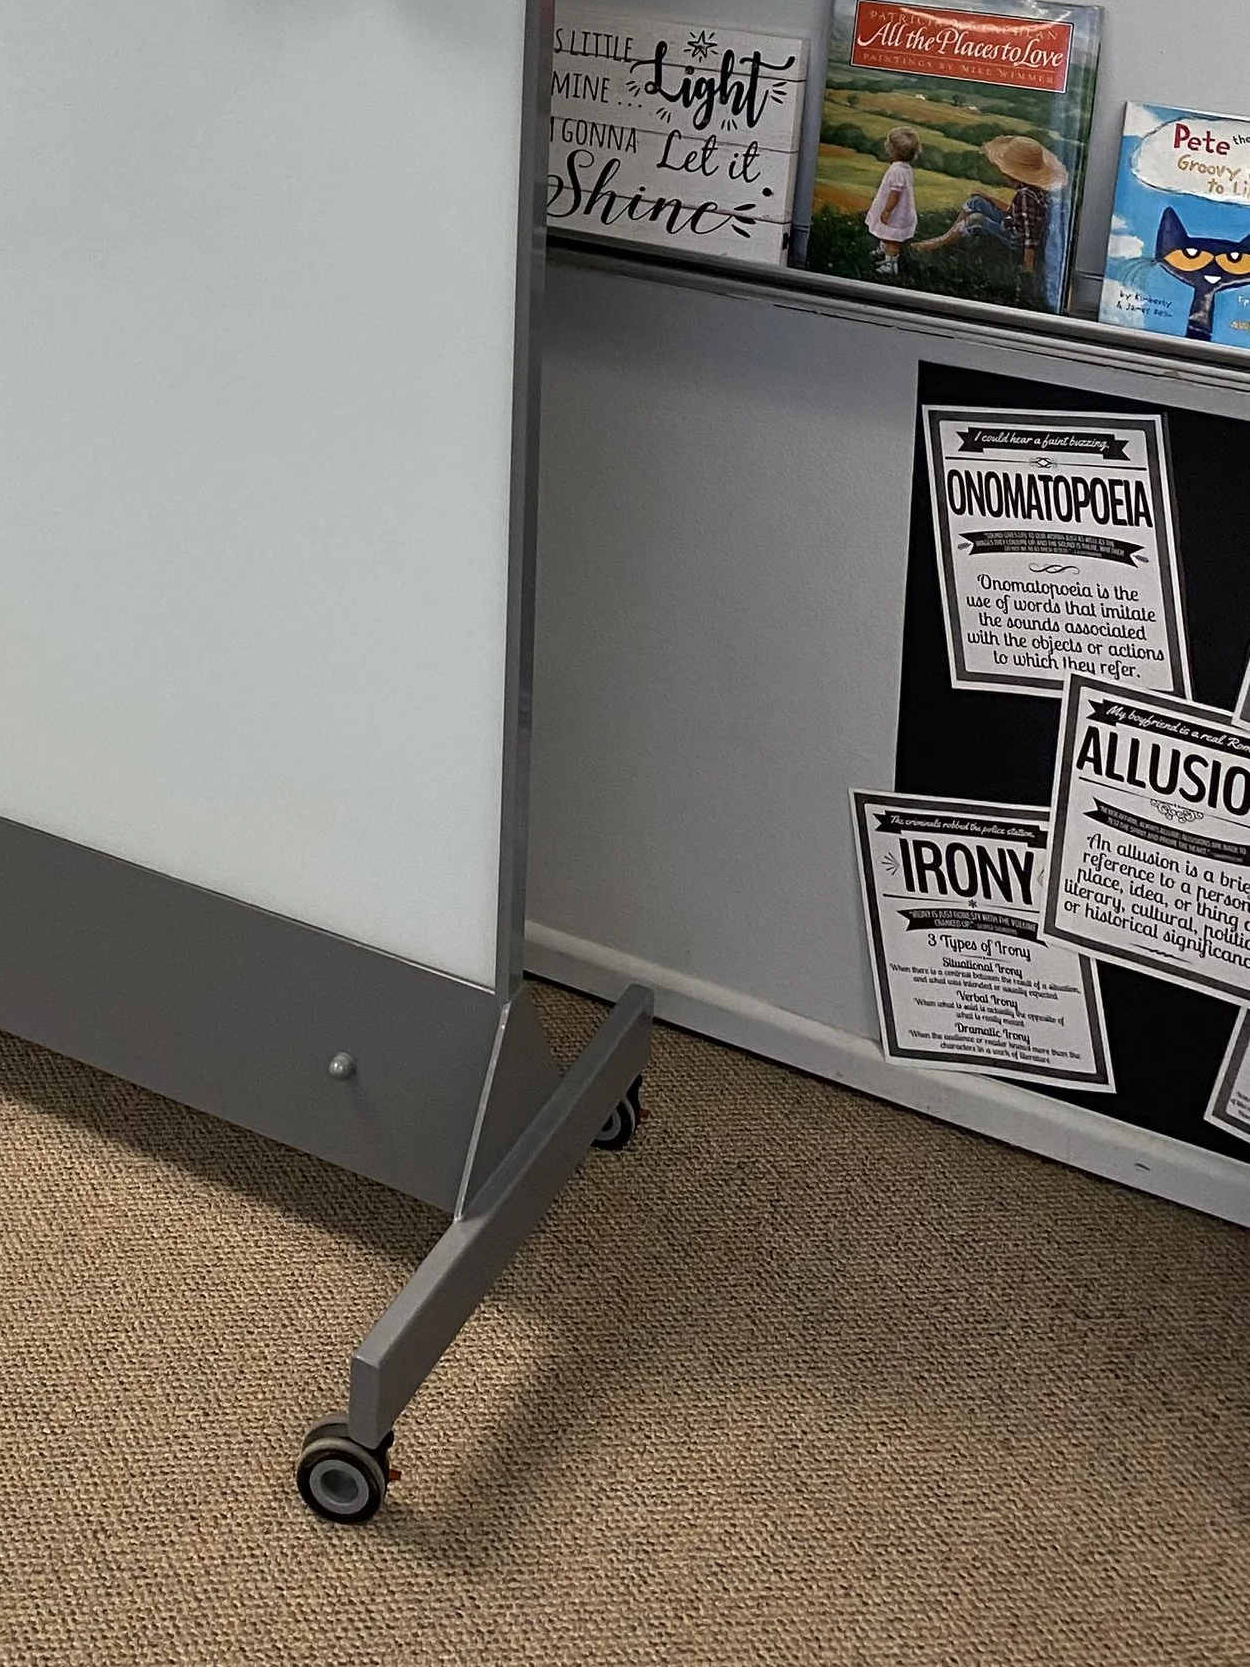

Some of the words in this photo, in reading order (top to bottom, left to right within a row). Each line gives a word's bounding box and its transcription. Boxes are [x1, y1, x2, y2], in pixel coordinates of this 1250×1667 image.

[569, 30, 634, 64] LITTLE
[857, 21, 903, 47] All
[906, 27, 934, 52] the
[935, 27, 1000, 60] Places
[1002, 43, 1020, 63] to
[1014, 37, 1064, 69] Love
[629, 40, 796, 131] Light
[863, 53, 933, 70] PAINTINGS
[939, 62, 953, 71] BY
[962, 64, 993, 76] MIKE
[999, 68, 1055, 85] WIMMER
[561, 118, 637, 154] GONNA
[1174, 123, 1230, 155] Pete
[656, 129, 719, 177] Let
[728, 140, 762, 183] it
[1177, 154, 1241, 182] Groovy
[547, 149, 734, 235] Shine
[1207, 178, 1225, 195] to
[1233, 180, 1250, 199] Li
[981, 432, 1009, 443] could
[1010, 432, 1032, 444] hear
[1033, 437, 1041, 445] a
[1041, 434, 1068, 449] faint
[947, 469, 1153, 528] ONOMATOPOEIA
[977, 574, 1093, 599] Onomatopoeia
[1096, 583, 1109, 599] is
[1114, 585, 1139, 601] the
[966, 596, 991, 608] use
[995, 595, 1010, 614] of
[1014, 599, 1061, 614] words
[1065, 601, 1097, 617] that
[1100, 603, 1156, 622] imitate
[979, 612, 1002, 627] the
[1007, 617, 1060, 632] sounds
[1065, 622, 1147, 641] associated
[967, 630, 1000, 646] with
[1004, 632, 1027, 648] the
[1031, 635, 1082, 655] objects
[1087, 643, 1103, 655] or
[1108, 643, 1165, 661] actions
[993, 650, 1008, 664] to
[1013, 652, 1059, 670] which
[1063, 656, 1095, 675] they
[1100, 660, 1141, 680] refer.
[1106, 705, 1127, 720] My
[1128, 710, 1179, 733] boyfriend
[1179, 724, 1190, 736] is
[1191, 731, 1200, 739] a
[1200, 734, 1227, 745] real
[1227, 737, 1250, 752] Rom
[1076, 725, 1250, 817] ALLUSIO
[890, 815, 904, 825] The
[905, 818, 941, 828] criminals
[942, 820, 969, 831] robbed
[981, 824, 1005, 835] police
[899, 837, 1034, 905] IRONY
[1083, 852, 1155, 883] reference
[1160, 872, 1175, 888] to
[1180, 882, 1191, 895] a
[1197, 885, 1250, 913] person
[1087, 833, 1112, 852] An
[1116, 843, 1180, 873] allusion
[1185, 860, 1198, 877] is
[1203, 870, 1214, 883] a
[1220, 871, 1250, 899] brie
[1064, 878, 1126, 914] literary,
[1131, 903, 1198, 935] cultural,
[1204, 924, 1250, 951] politic
[1077, 868, 1124, 894] place,
[1130, 880, 1168, 908] idea,
[1174, 898, 1192, 911] or
[1197, 902, 1239, 933] thing
[928, 933, 937, 947] 3
[940, 934, 977, 952] Types
[981, 939, 993, 956] of
[995, 940, 1031, 962] Irony
[1064, 900, 1080, 913] or
[1085, 902, 1158, 939] historical
[1163, 929, 1250, 969] significanc
[942, 957, 993, 973] Situational
[995, 963, 1023, 979] Irony
[956, 990, 989, 1004] Verbal
[990, 994, 1018, 1013] Irony
[955, 1022, 1002, 1038] Dramatic
[1002, 1028, 1030, 1045] Irony
